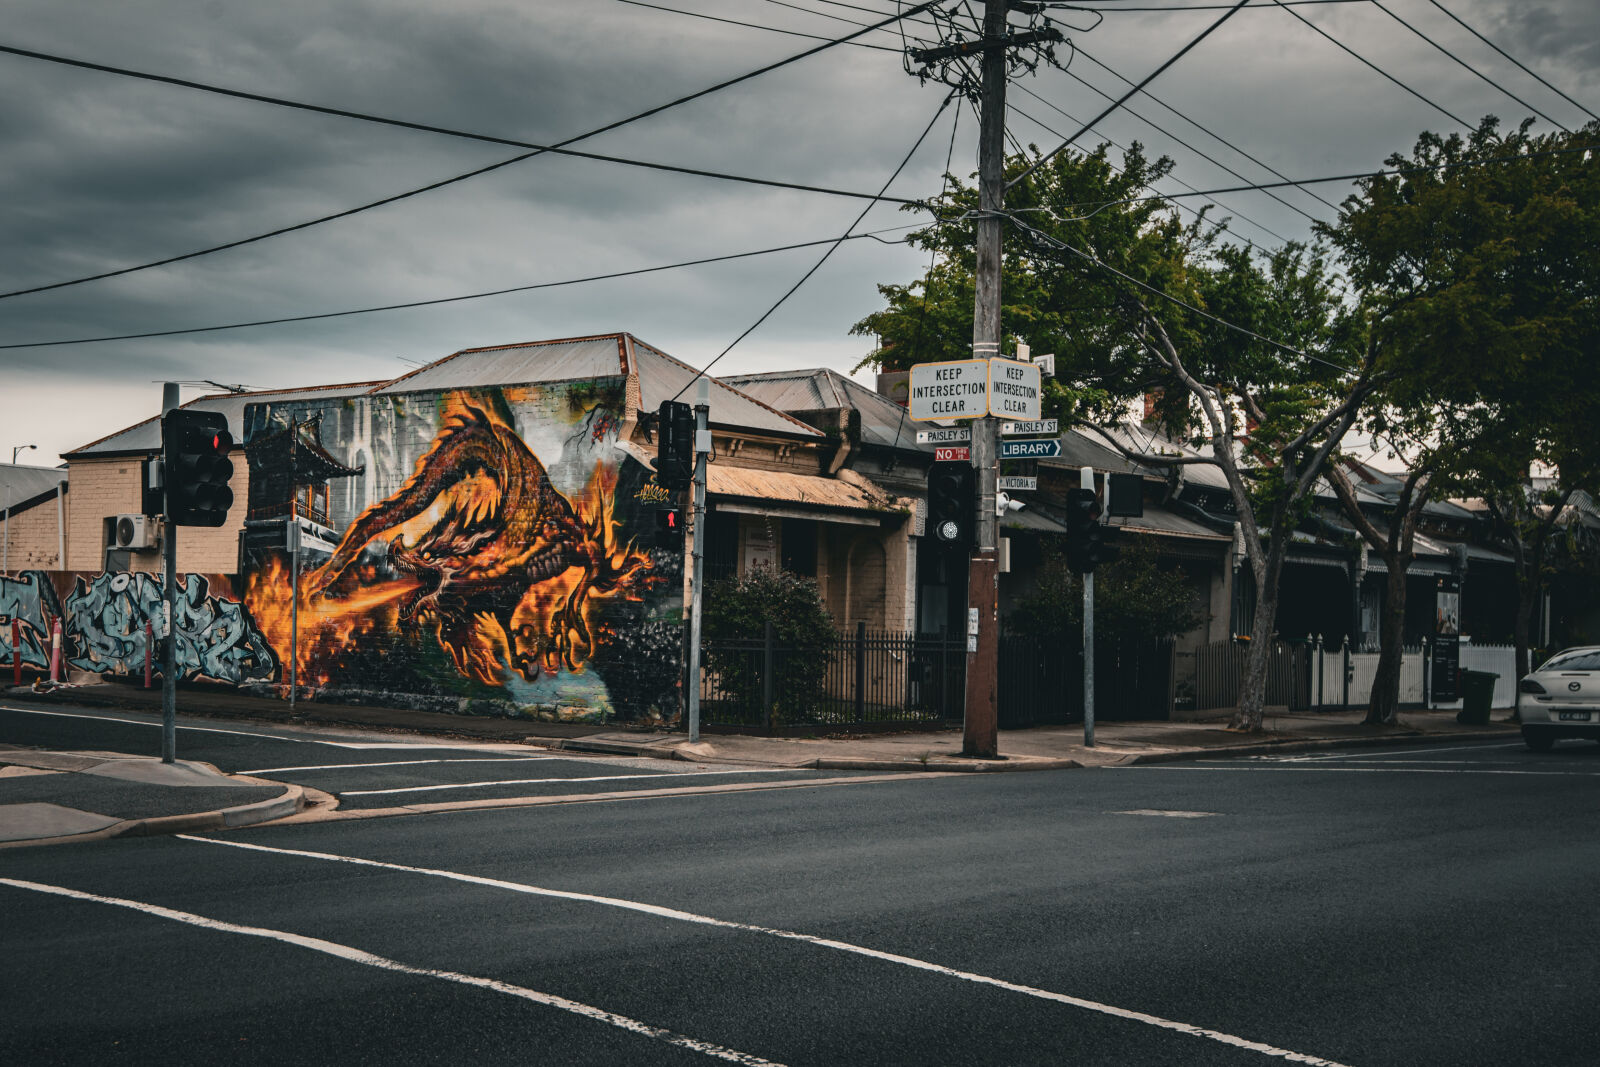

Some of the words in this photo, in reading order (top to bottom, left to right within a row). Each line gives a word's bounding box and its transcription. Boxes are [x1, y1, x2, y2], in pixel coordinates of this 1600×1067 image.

[936, 368, 962, 381] KEEP
[1006, 367, 1024, 381] KEEP
[913, 382, 986, 399] INTERSECTION
[993, 381, 1037, 399] INTERSECTION
[932, 400, 965, 414] CLEAR
[1004, 399, 1027, 414] CLEAR
[1014, 423, 1045, 433] PAISLEY
[1047, 421, 1057, 431] ST
[927, 431, 958, 442] PAISLEY
[960, 430, 969, 440] ST
[936, 450, 953, 460] NO
[1002, 443, 1052, 456] LIBRARY
[1005, 479, 1030, 489] VICTORIA
[1030, 481, 1036, 489] ST
